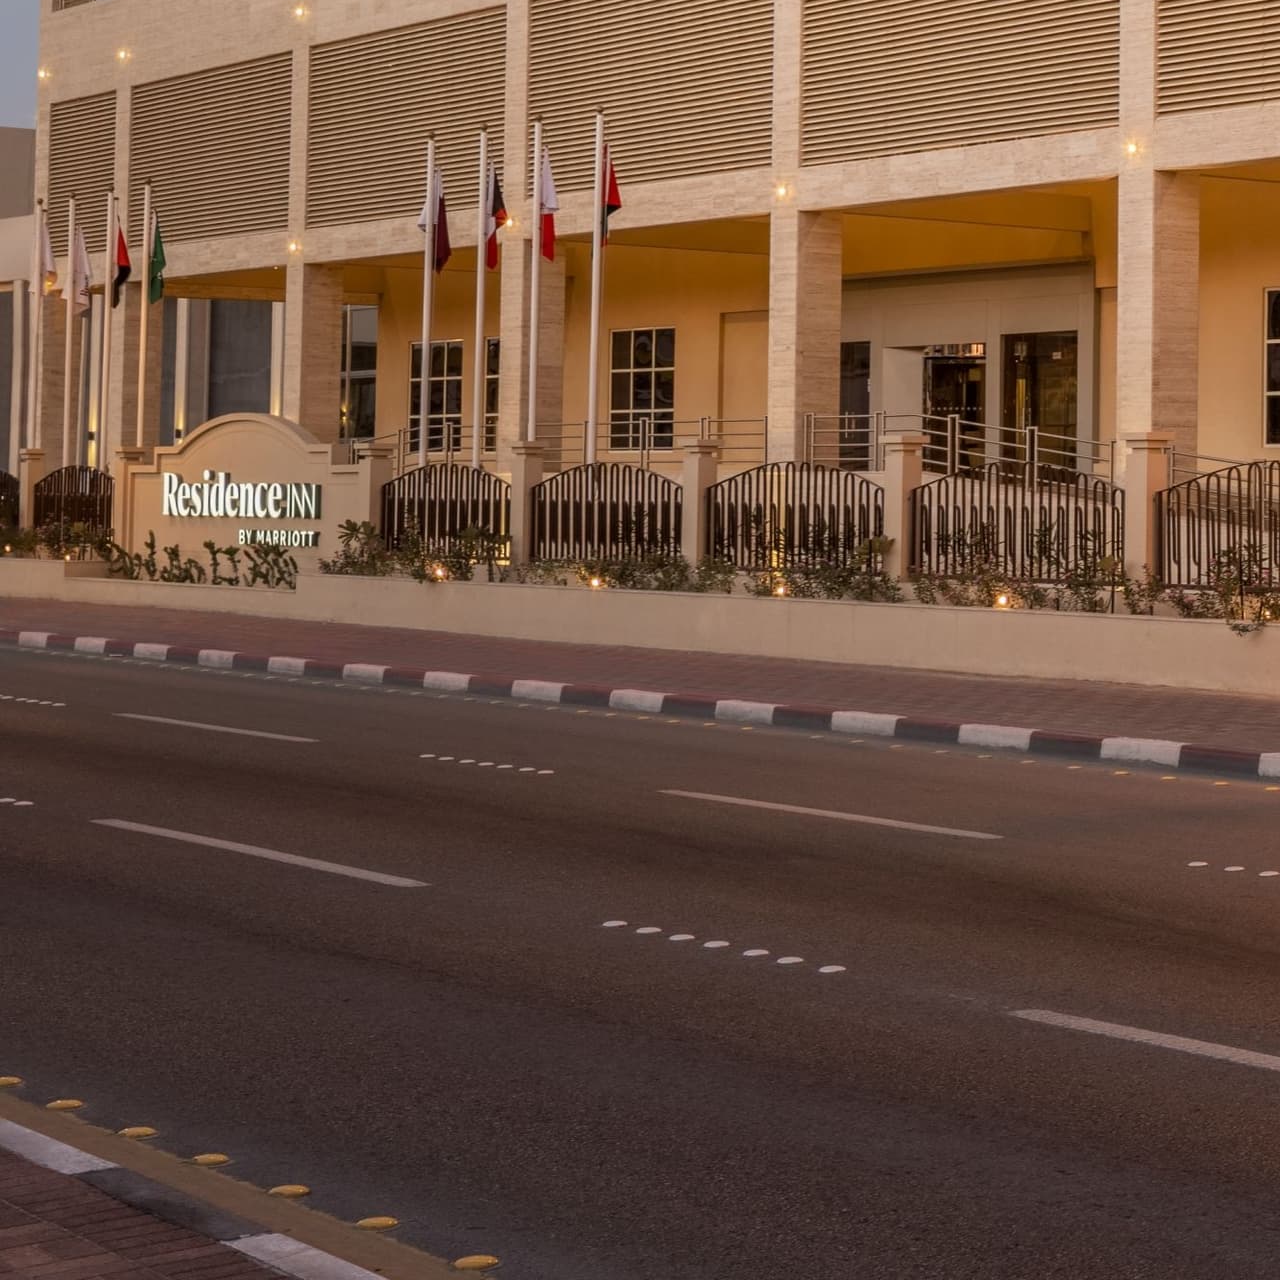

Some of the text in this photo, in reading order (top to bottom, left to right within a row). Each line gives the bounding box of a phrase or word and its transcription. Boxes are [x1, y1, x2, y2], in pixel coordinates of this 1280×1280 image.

[162, 468, 317, 519] Residence INN
[238, 528, 316, 548] BY MARRIOTT
